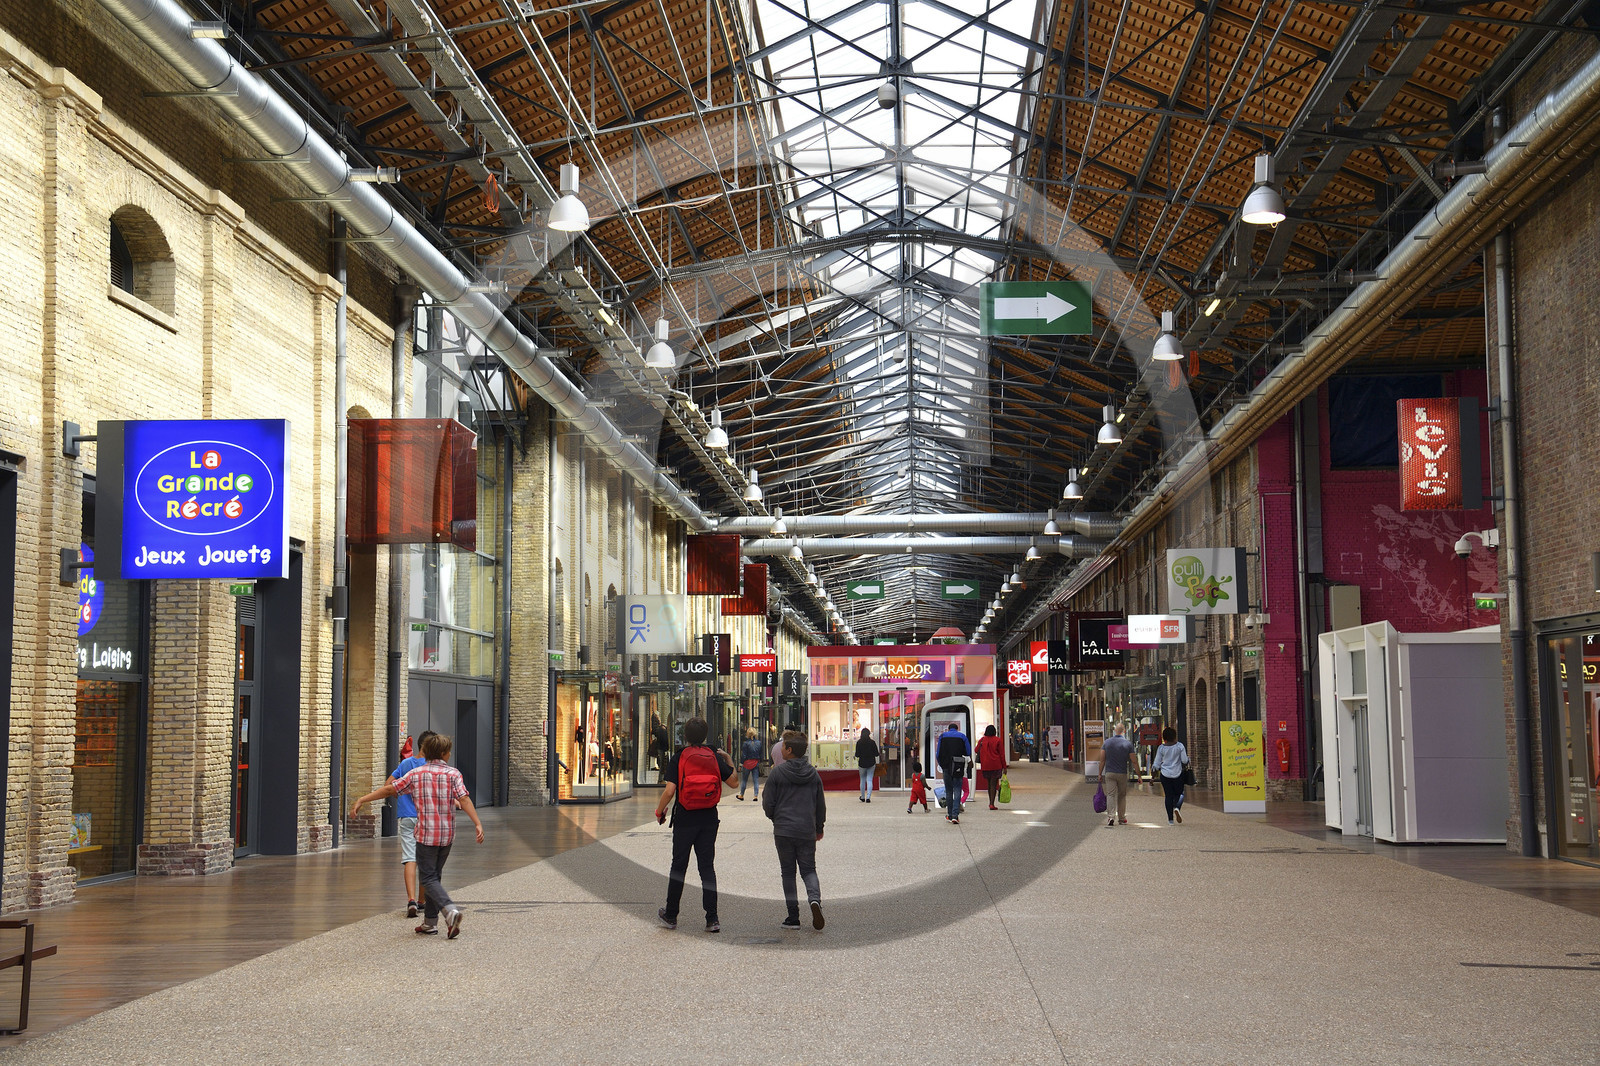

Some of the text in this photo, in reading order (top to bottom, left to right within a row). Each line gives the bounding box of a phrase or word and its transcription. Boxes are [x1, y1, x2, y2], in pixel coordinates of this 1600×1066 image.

[190, 450, 220, 469] La
[157, 473, 252, 493] Grande
[166, 495, 242, 519] Récré
[134, 545, 271, 567] Jeux Jouets
[1173, 562, 1203, 583] gulli
[1187, 576, 1219, 599] Parc
[1164, 625, 1180, 633] SFR
[92, 642, 132, 670] Loisirs
[741, 658, 774, 668] ESPRIT
[871, 664, 932, 675] CARADOR
[1008, 661, 1031, 673] plein
[1008, 671, 1032, 684] ciel
